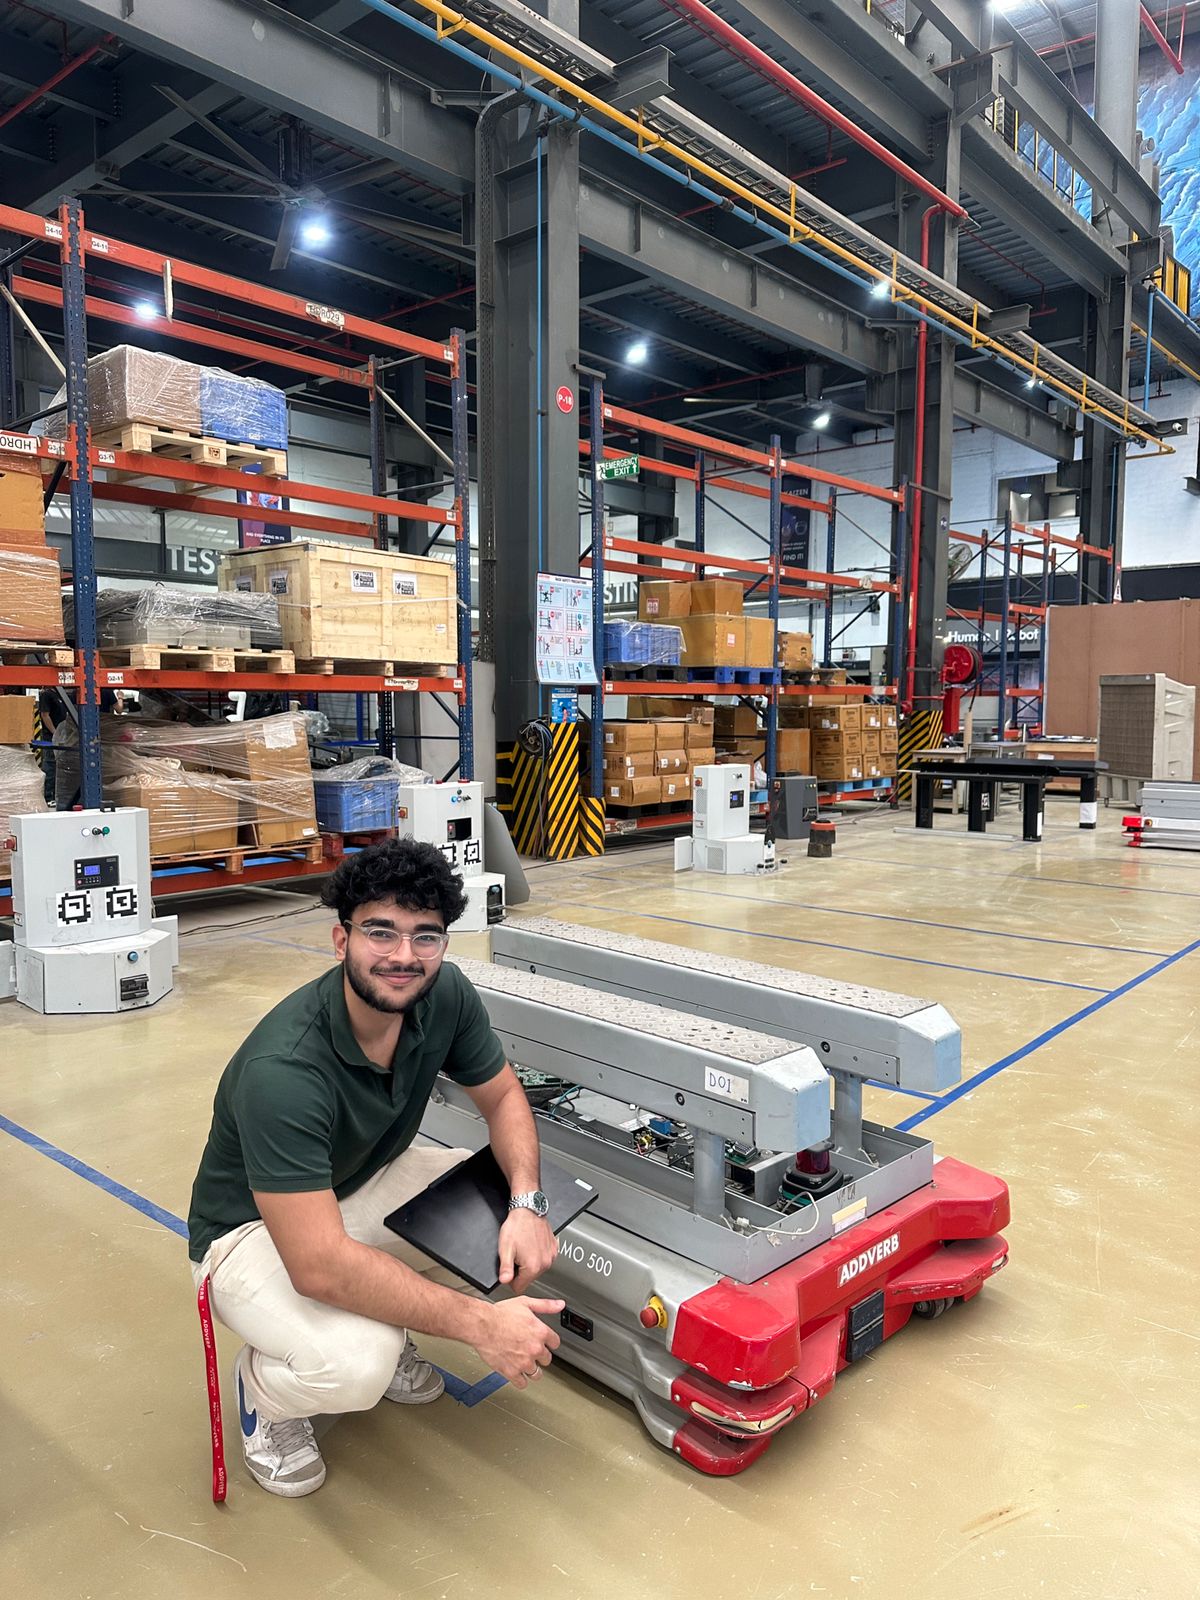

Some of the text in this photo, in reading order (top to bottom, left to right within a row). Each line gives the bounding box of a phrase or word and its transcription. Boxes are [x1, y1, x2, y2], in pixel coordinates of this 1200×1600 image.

[605, 456, 638, 469] EMERGENCY
[614, 466, 630, 476] EXIT
[166, 545, 220, 575] TES
[586, 1252, 613, 1277] 500
[839, 1233, 899, 1285] ADDVERB
